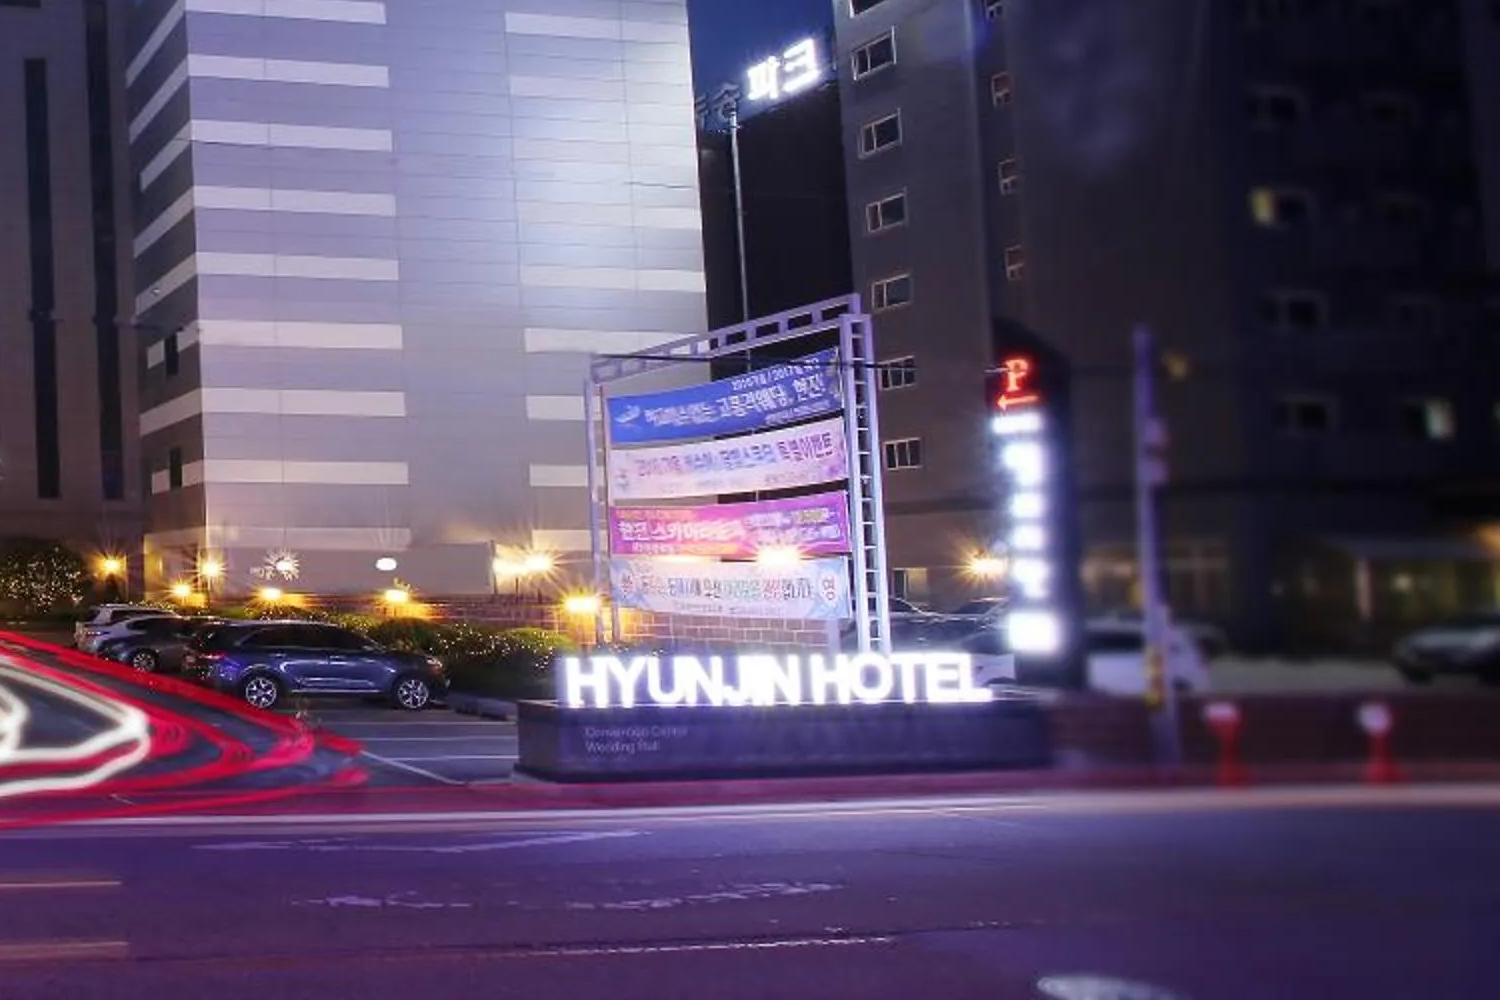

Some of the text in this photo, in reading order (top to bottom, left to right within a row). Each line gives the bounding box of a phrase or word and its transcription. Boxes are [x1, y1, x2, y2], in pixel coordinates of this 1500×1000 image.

[1003, 357, 1032, 392] P
[563, 651, 994, 708] HYUNJIN HOTEL
[585, 740, 636, 754] Wedding
